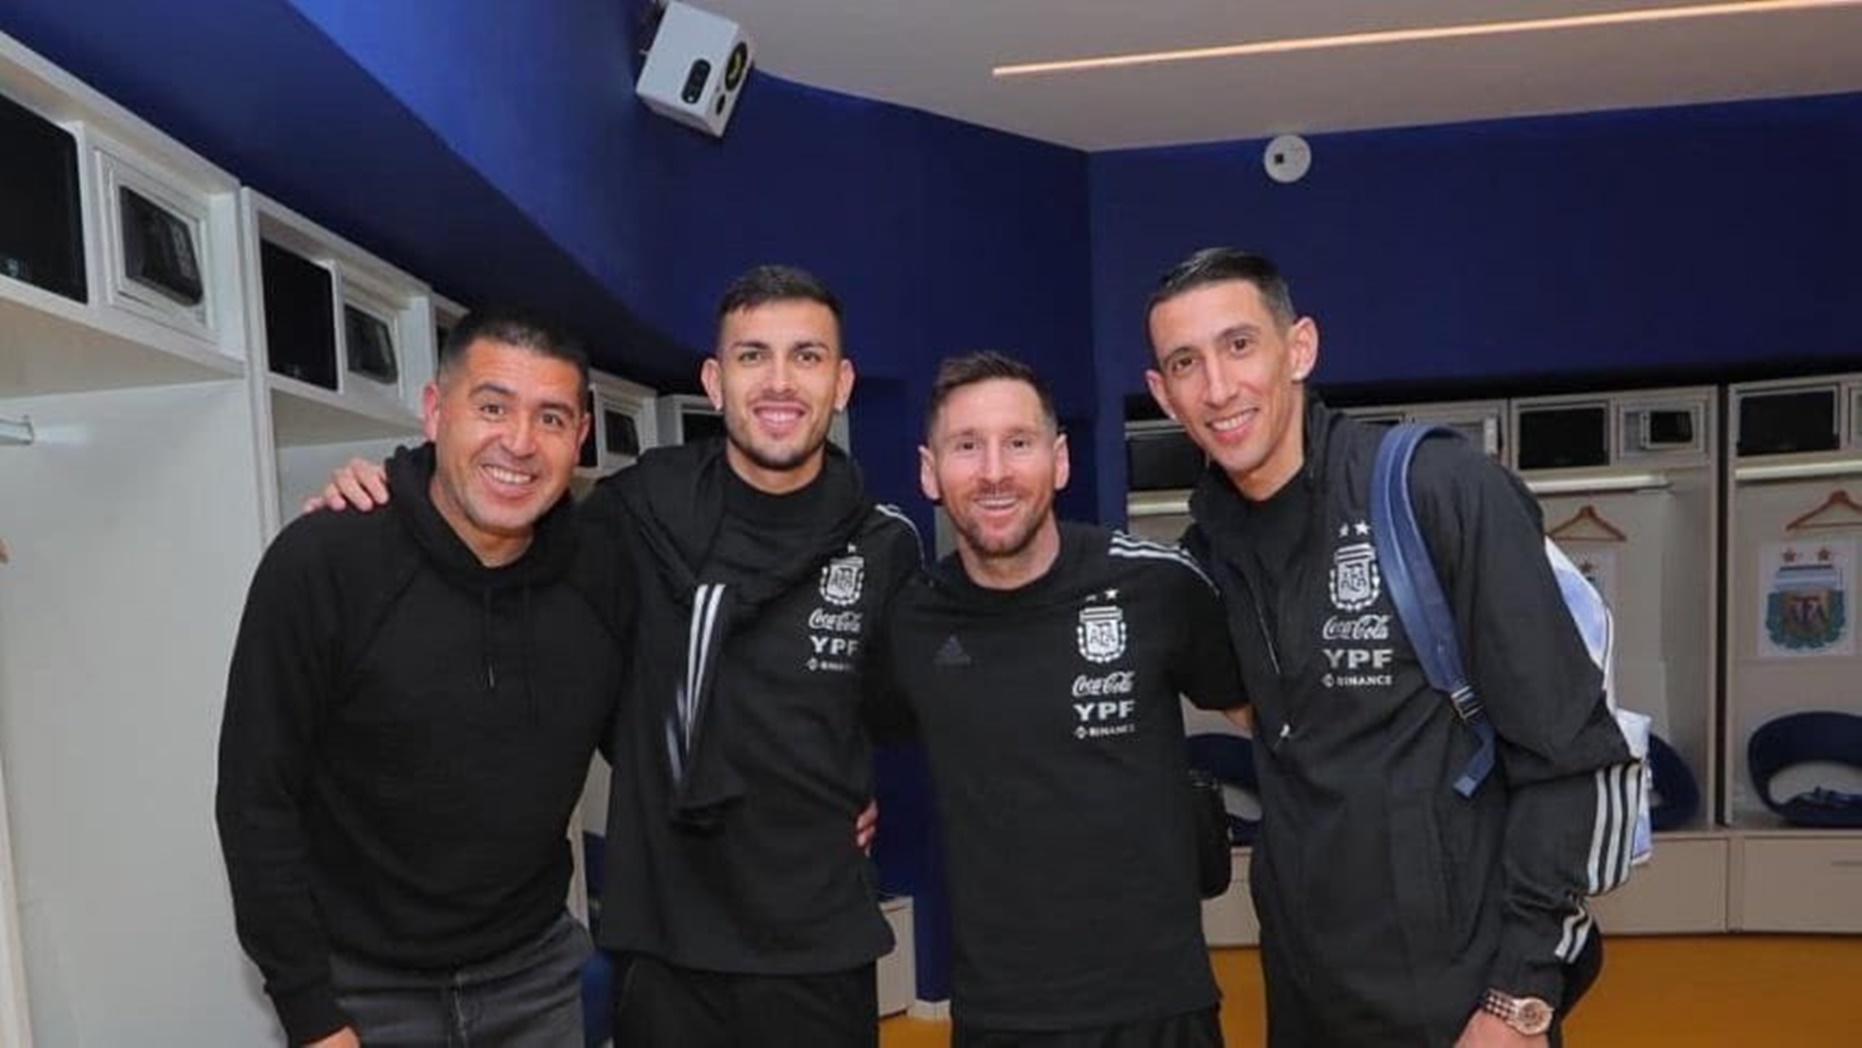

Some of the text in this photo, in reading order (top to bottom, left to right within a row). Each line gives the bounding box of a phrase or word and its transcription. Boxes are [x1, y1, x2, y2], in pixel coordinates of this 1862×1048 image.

[809, 635, 859, 656] YPF
[1323, 649, 1393, 668] YPF
[1073, 700, 1134, 720] YPF
